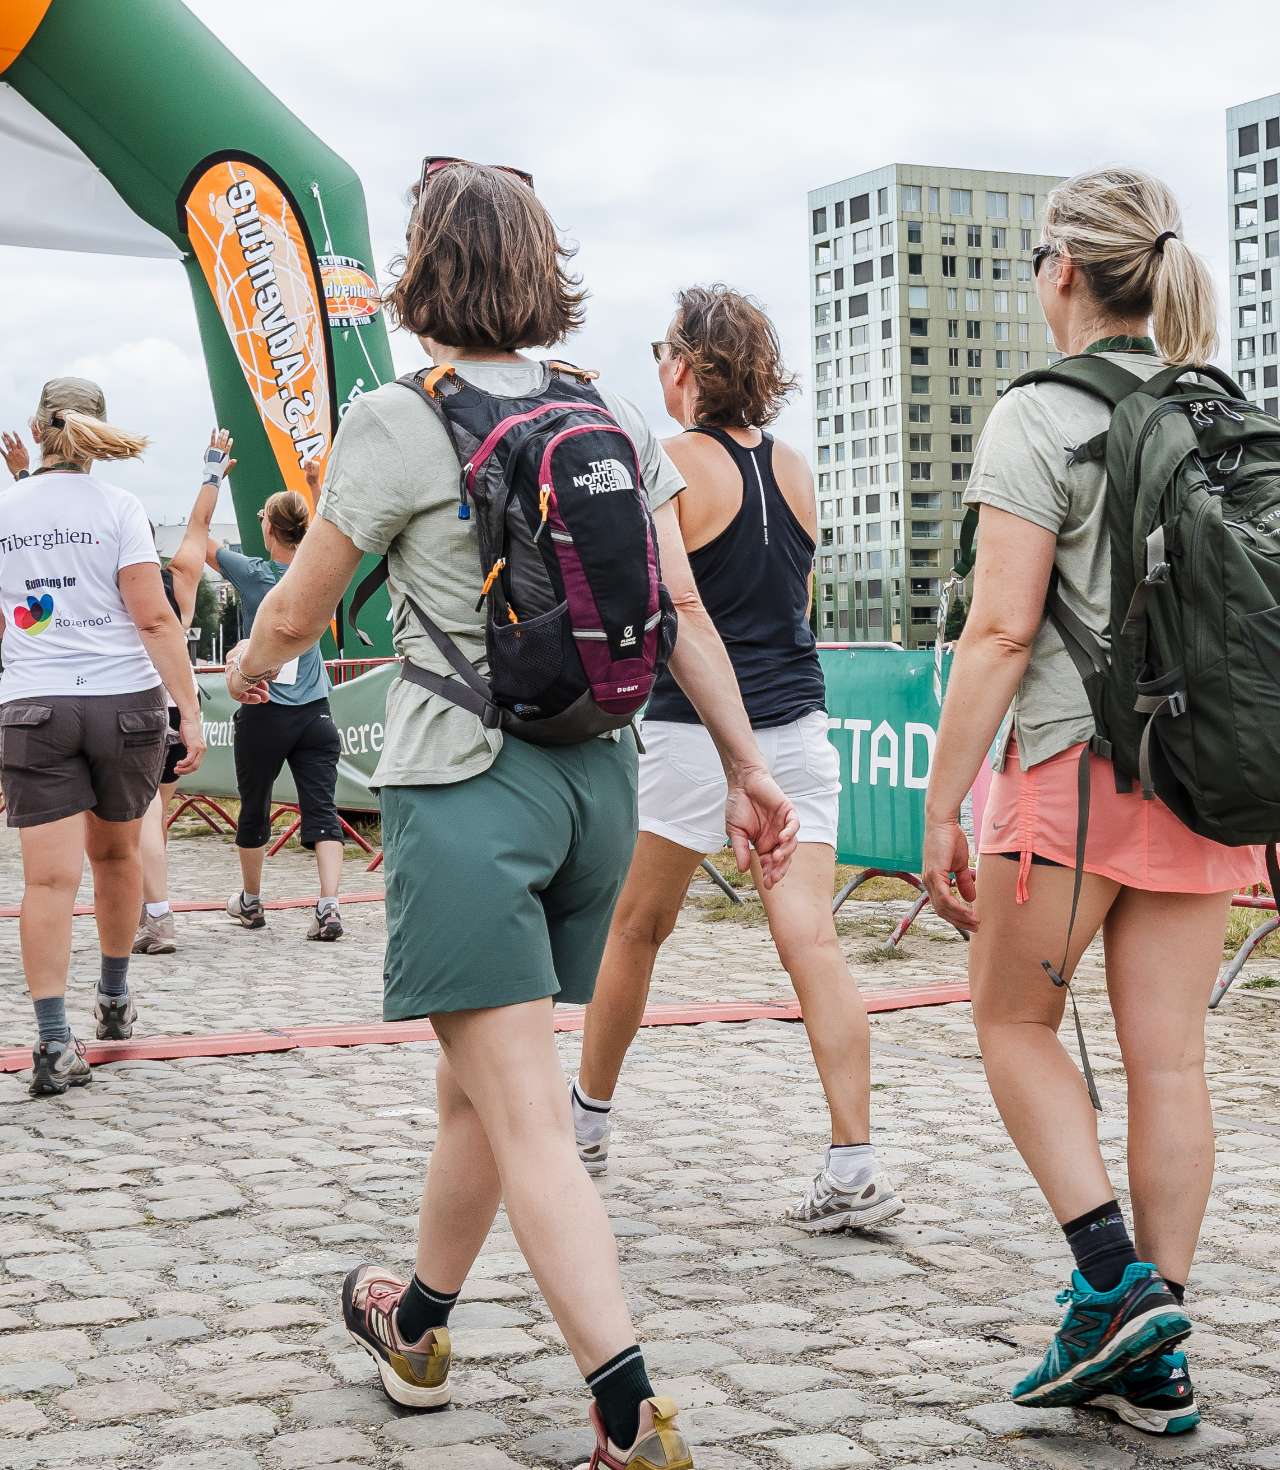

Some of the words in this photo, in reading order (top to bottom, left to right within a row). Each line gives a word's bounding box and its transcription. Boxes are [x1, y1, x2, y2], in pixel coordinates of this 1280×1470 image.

[588, 459, 613, 473] THE
[572, 470, 615, 488] NORTH
[588, 479, 619, 495] FACE
[63, 575, 76, 588] for
[827, 718, 937, 789] TAD
